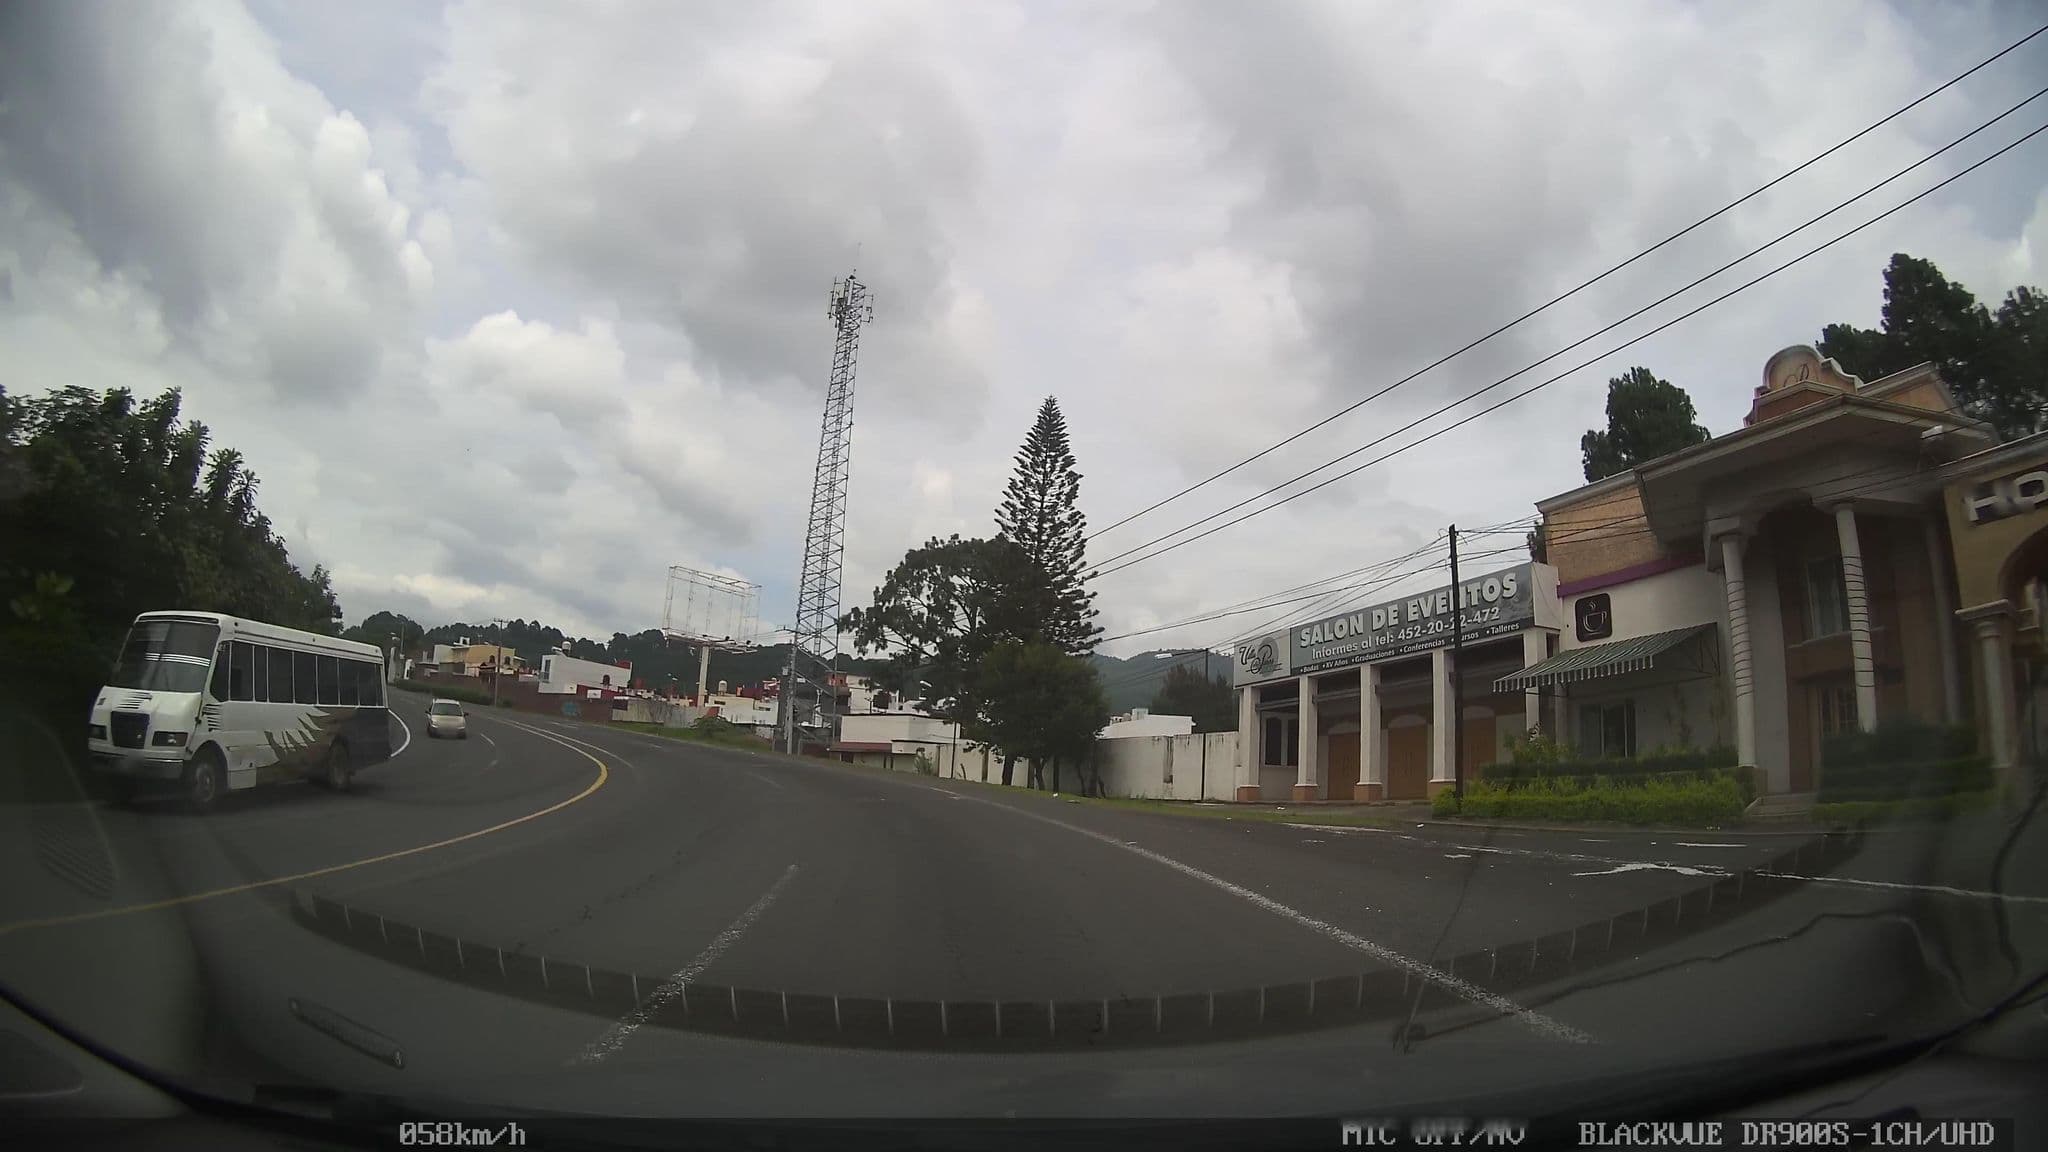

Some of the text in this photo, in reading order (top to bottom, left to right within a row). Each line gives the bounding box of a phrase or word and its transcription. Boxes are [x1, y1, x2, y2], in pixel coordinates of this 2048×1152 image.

[1300, 572, 1518, 648] SALON DE EVENTOS
[1312, 642, 1358, 660] Informes
[1361, 635, 1372, 649] al
[1375, 631, 1394, 646] tel:
[1403, 639, 1446, 653] Conferencias
[1490, 622, 1520, 634] Talleres
